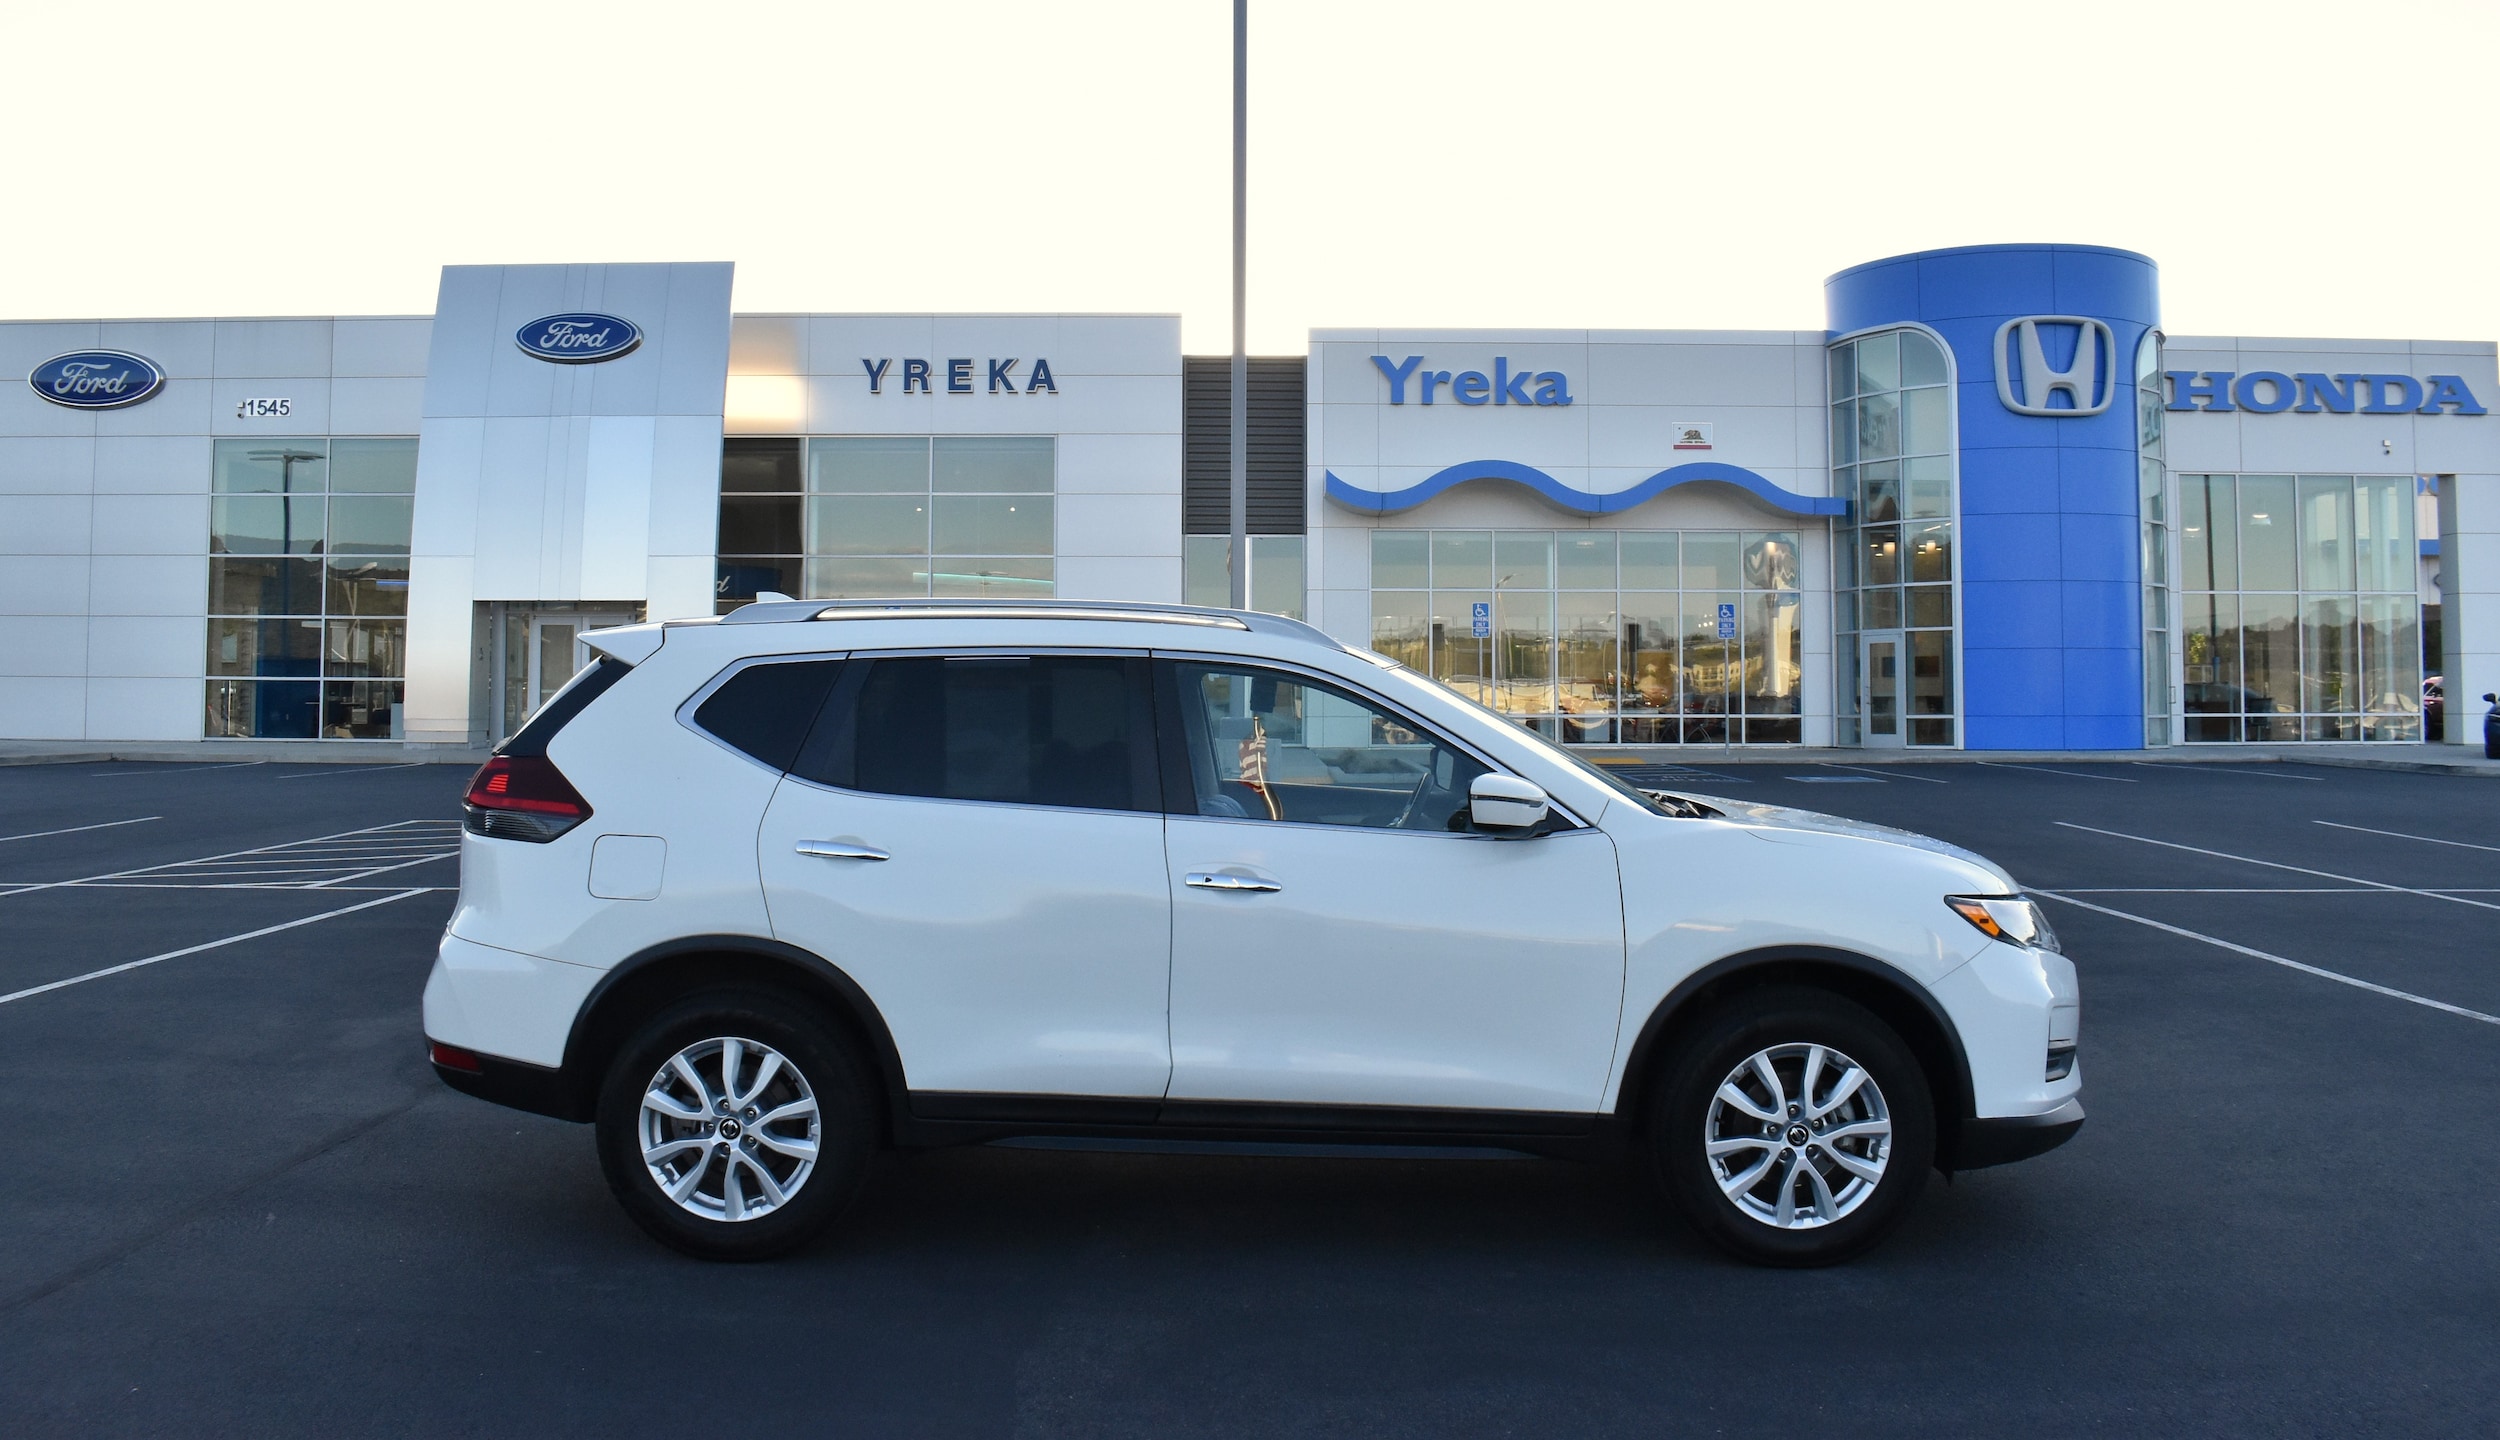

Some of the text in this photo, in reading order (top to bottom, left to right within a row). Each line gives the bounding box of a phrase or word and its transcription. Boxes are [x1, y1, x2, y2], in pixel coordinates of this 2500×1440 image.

[540, 321, 611, 348] Ford
[53, 362, 130, 394] Ford
[861, 358, 1059, 394] YREKA
[1370, 356, 1574, 406] Yreka
[2164, 370, 2488, 415] HONDA
[247, 399, 290, 416] 1545
